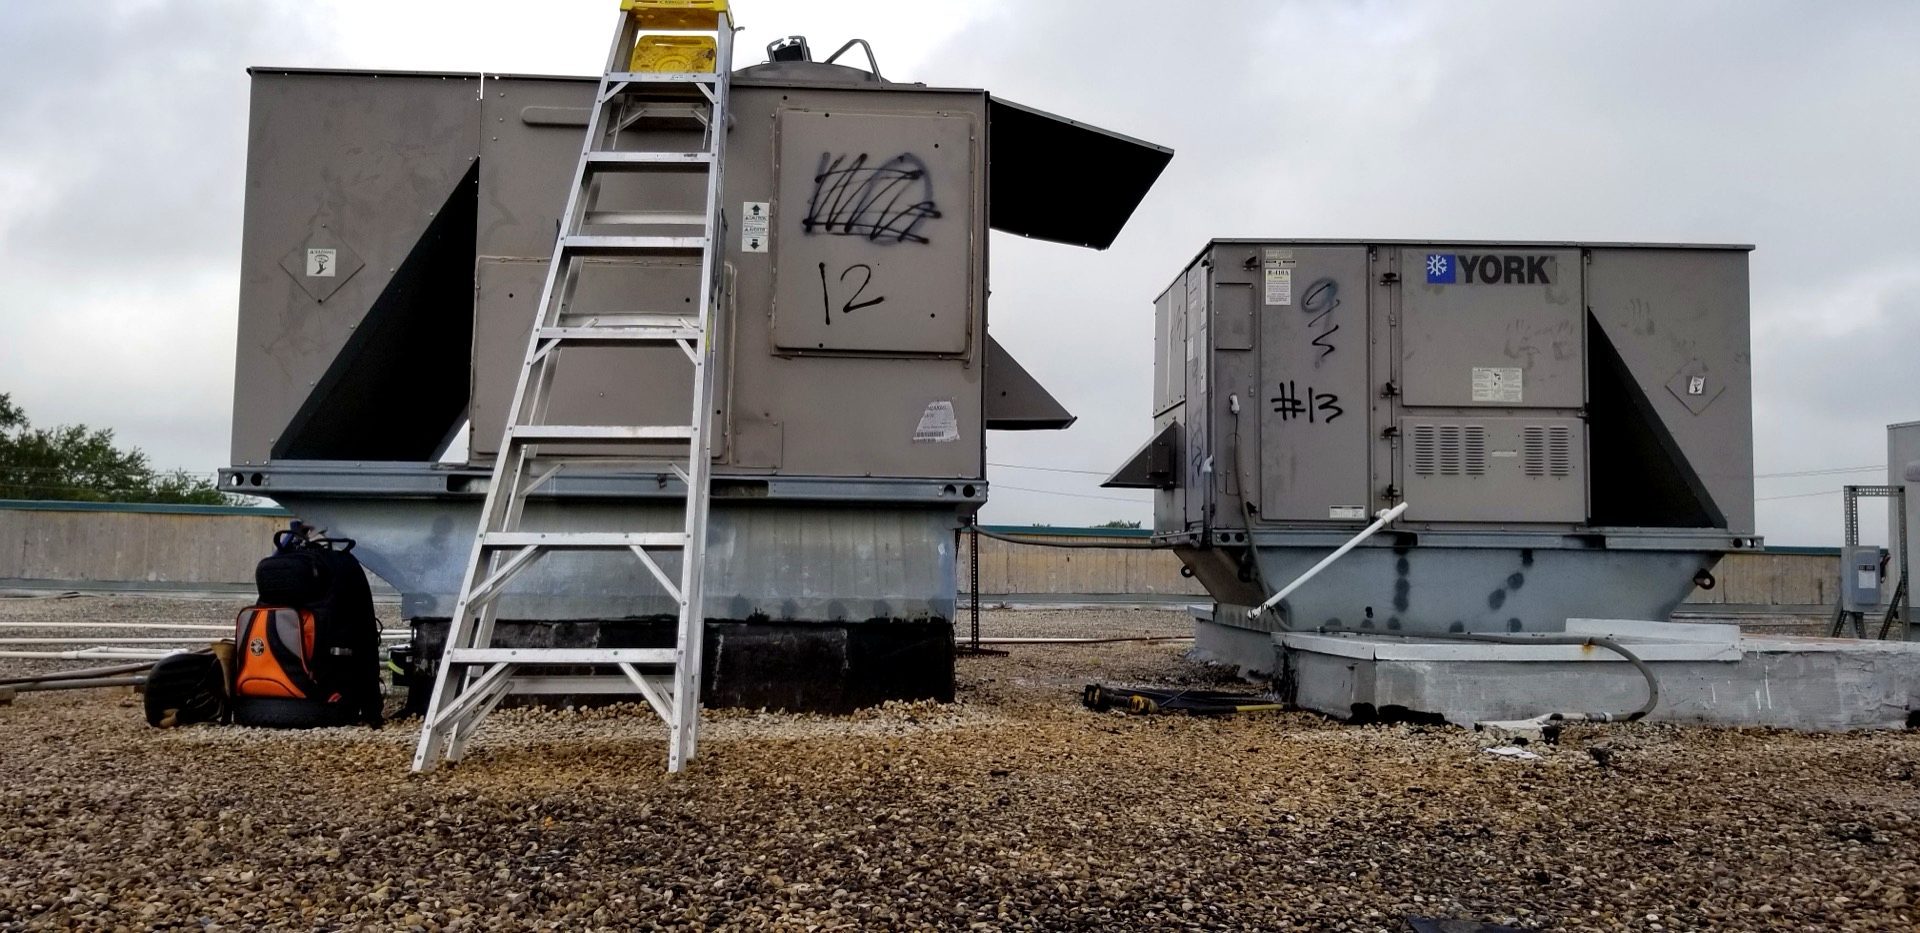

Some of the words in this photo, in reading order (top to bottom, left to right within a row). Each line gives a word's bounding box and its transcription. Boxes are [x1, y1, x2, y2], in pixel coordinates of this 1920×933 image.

[1457, 254, 1551, 284] YORK
[819, 262, 885, 325] 12
[1271, 380, 1344, 424] #13
